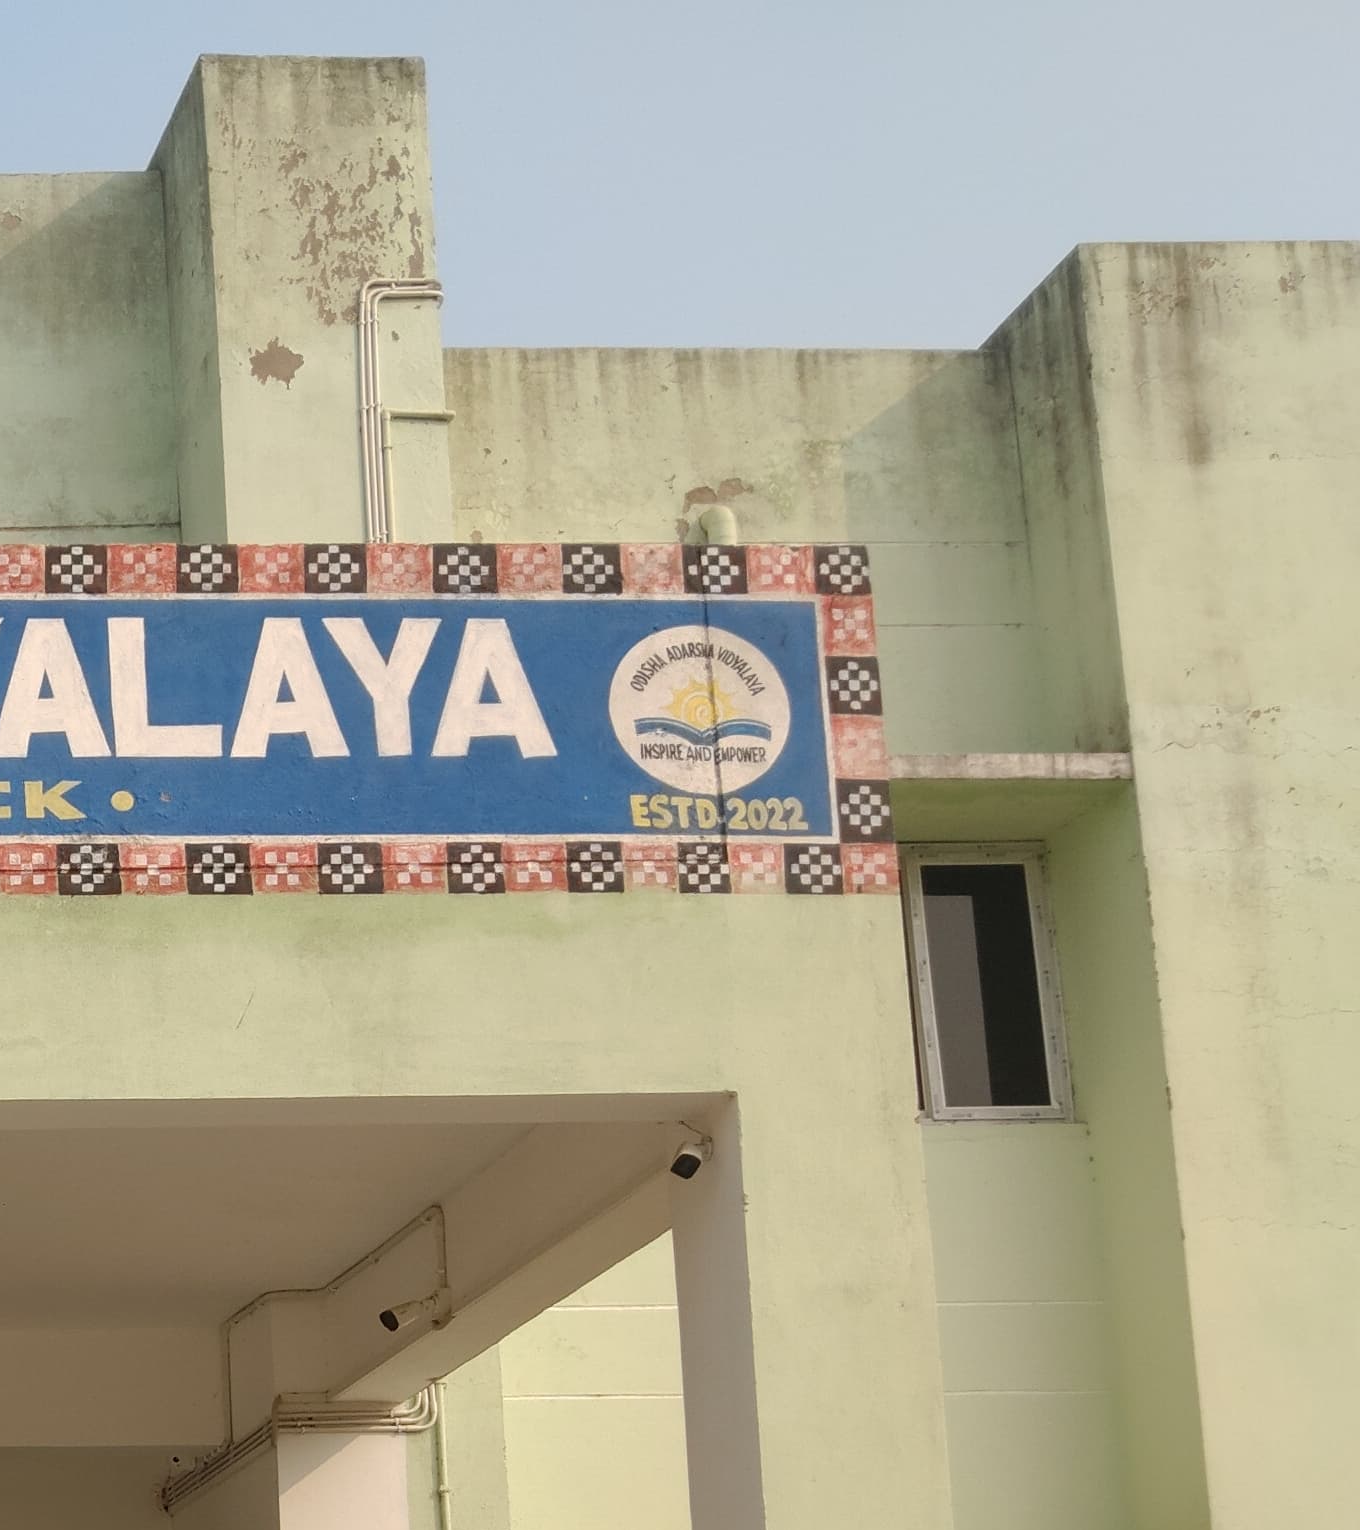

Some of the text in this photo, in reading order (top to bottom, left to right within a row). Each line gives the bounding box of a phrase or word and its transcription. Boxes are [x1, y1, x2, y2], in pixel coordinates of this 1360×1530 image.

[630, 642, 766, 697] ODISHA ADARSHA VIDYALAYA
[640, 743, 767, 764] INSPIRE AND EMPOWER
[726, 797, 809, 831] 2022
